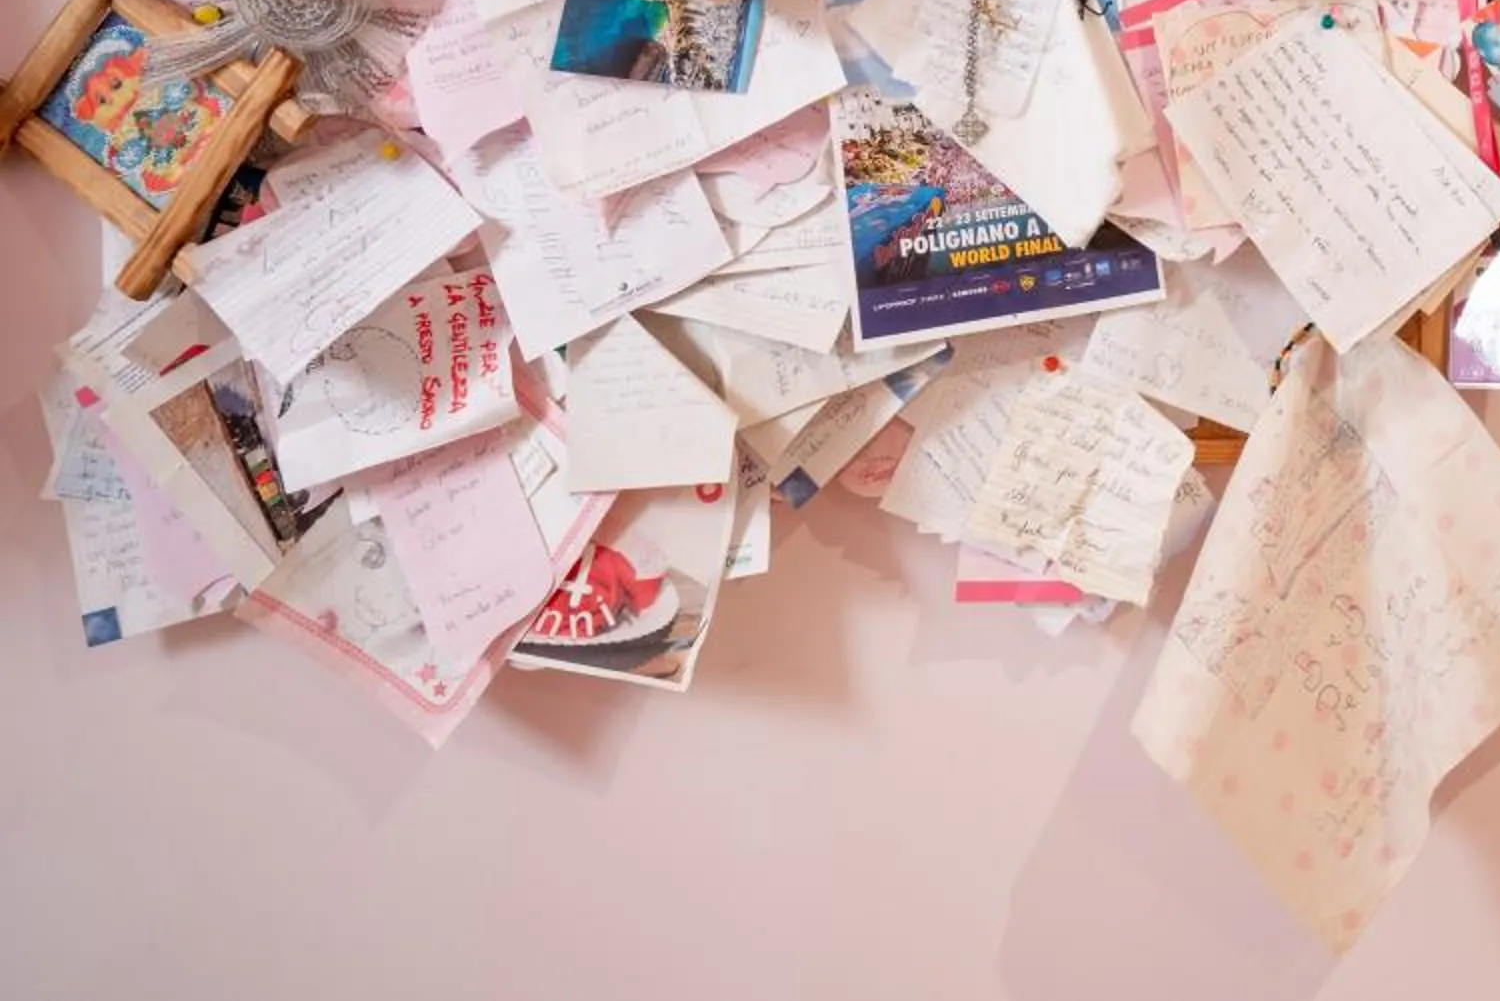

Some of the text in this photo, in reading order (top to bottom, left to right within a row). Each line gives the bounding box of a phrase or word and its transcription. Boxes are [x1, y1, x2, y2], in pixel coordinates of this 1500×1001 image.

[900, 219, 1040, 257] POLIGNANO A
[949, 246, 1009, 269] WORLD
